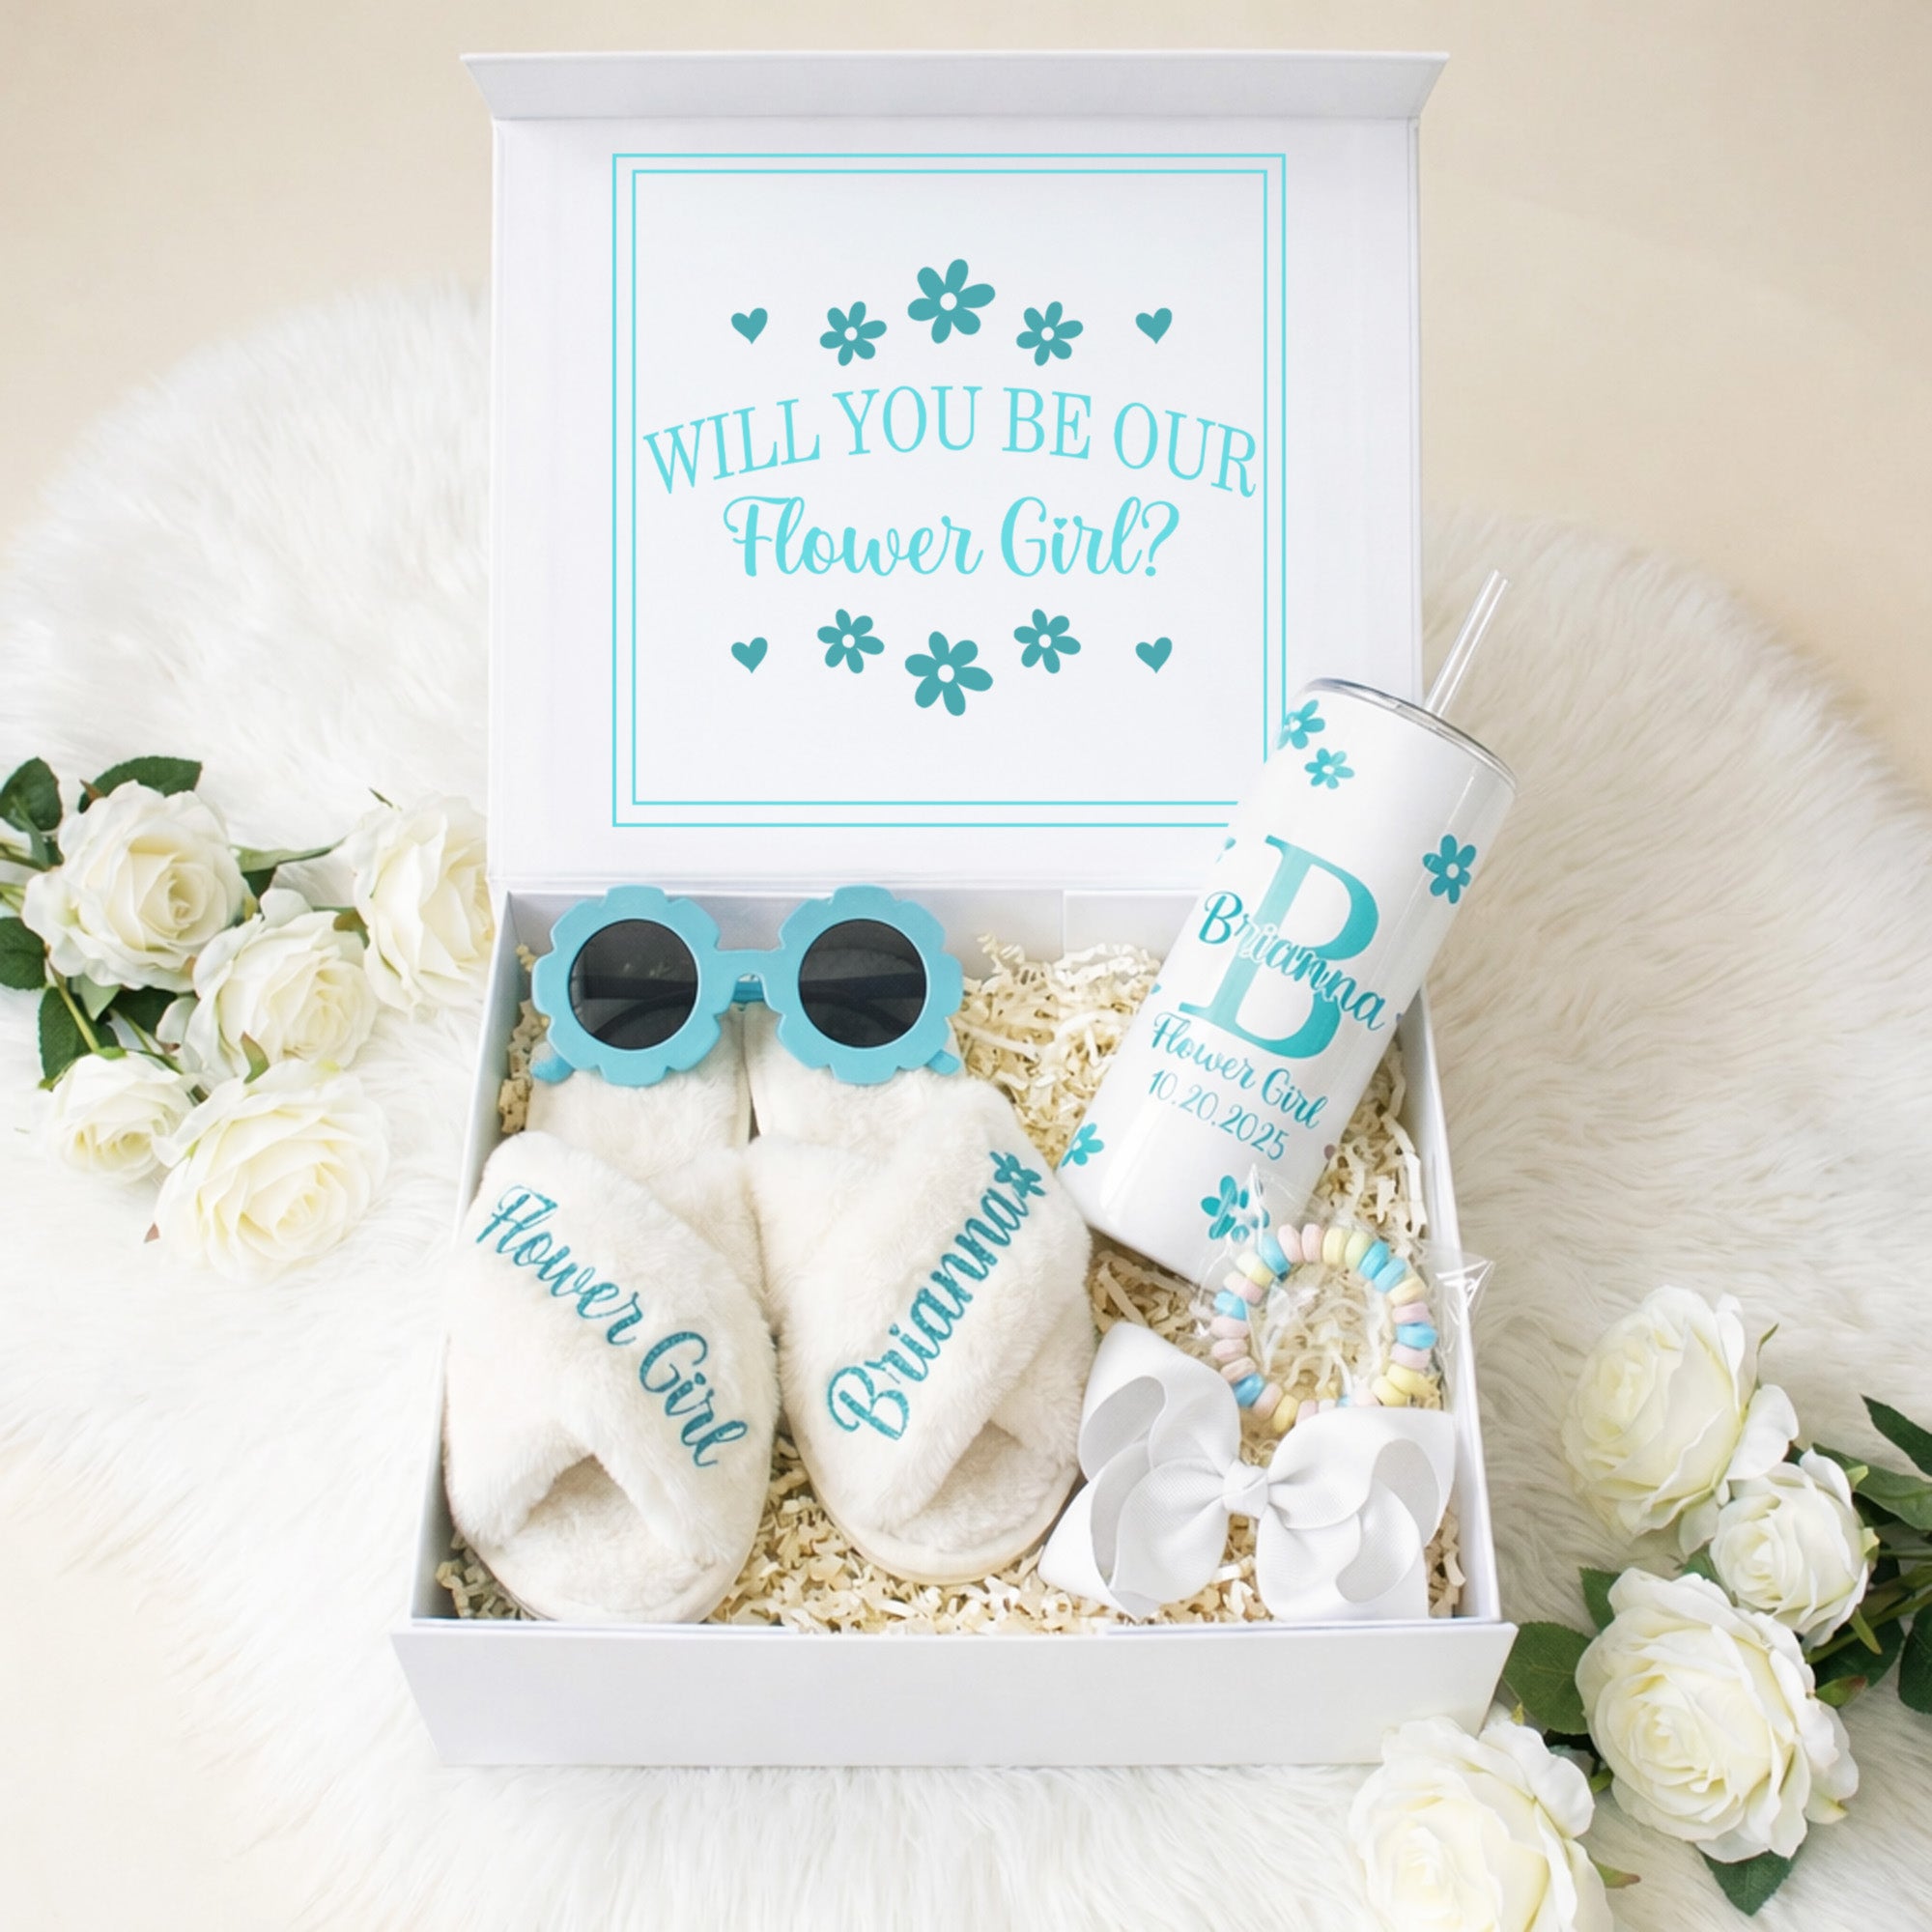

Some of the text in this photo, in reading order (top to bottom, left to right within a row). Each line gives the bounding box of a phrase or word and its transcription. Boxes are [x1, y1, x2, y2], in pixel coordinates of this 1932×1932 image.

[642, 385, 1257, 498] WILL YOU BE OUR
[723, 496, 1179, 578] Flower Girl?
[1178, 834, 1379, 1060] B
[1197, 890, 1386, 1032] Brianna
[1147, 1068, 1288, 1162] 10.20.2025
[1152, 1012, 1329, 1129] Flower Girl
[475, 1184, 749, 1467] Flower Girl
[825, 1179, 1031, 1440] Brianna
